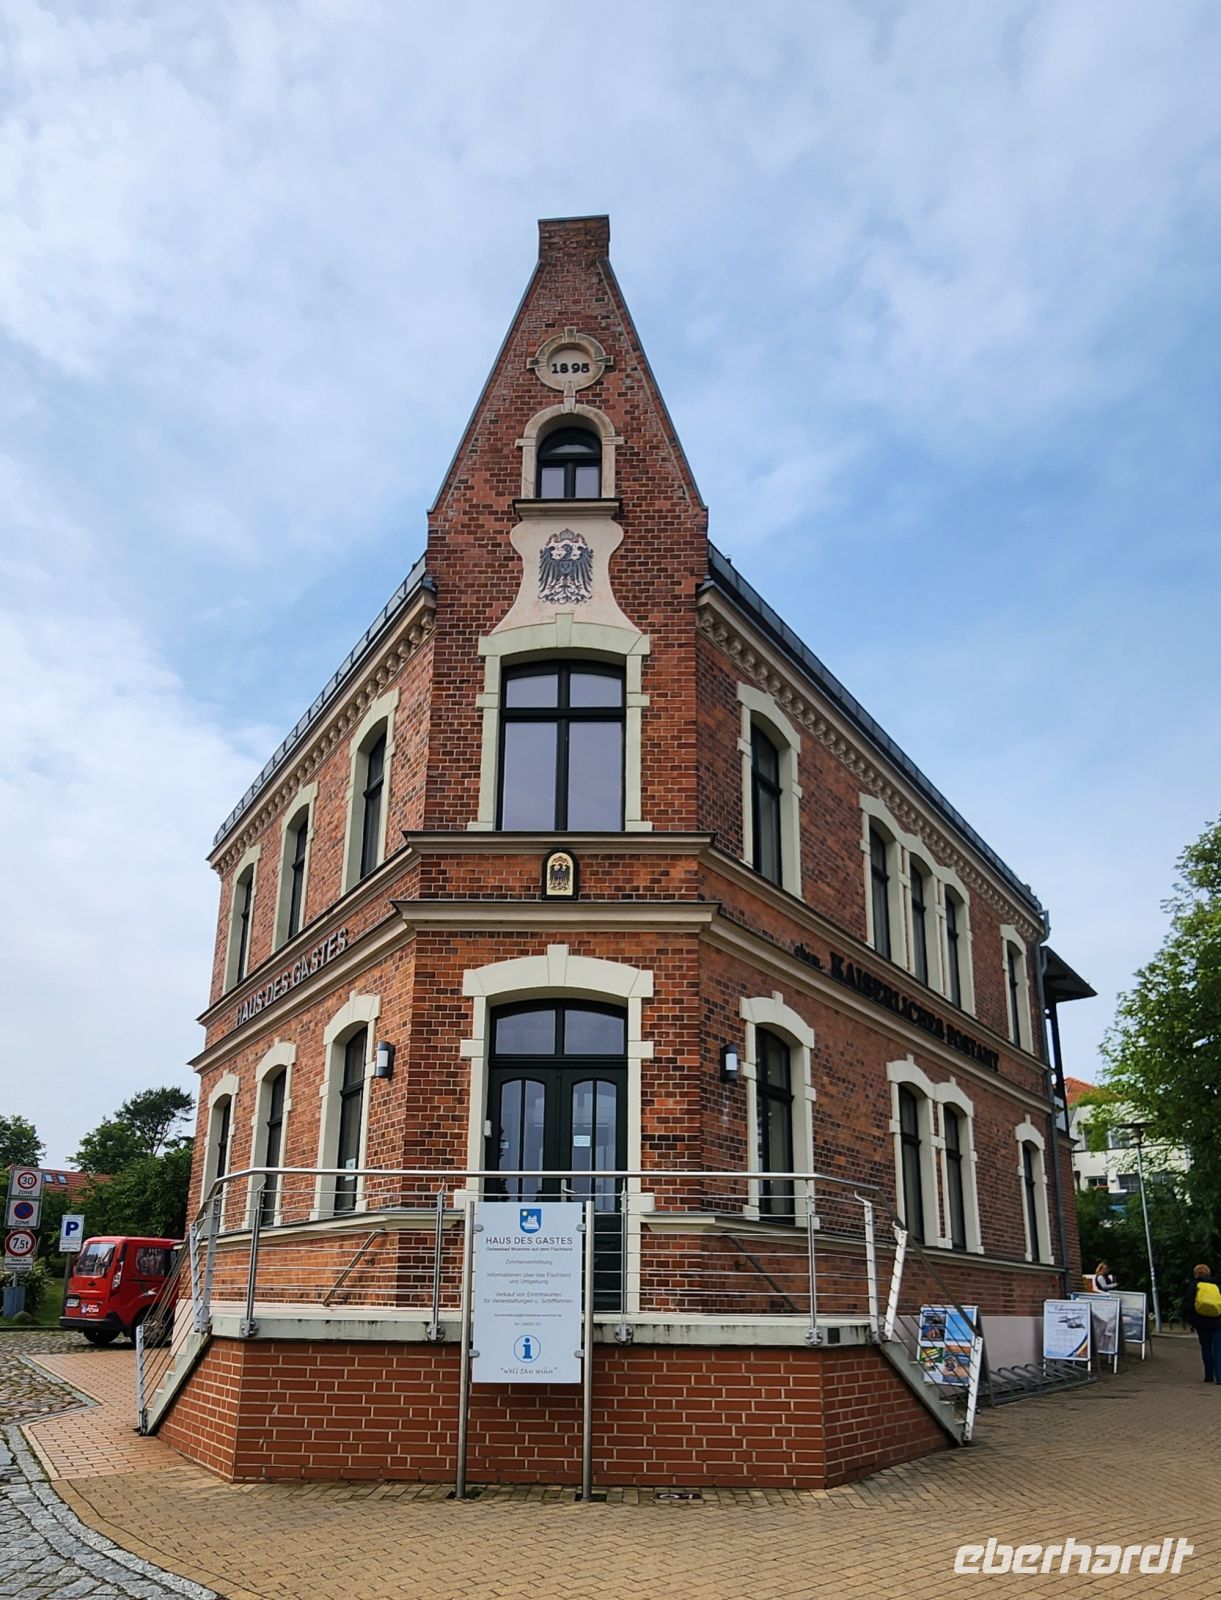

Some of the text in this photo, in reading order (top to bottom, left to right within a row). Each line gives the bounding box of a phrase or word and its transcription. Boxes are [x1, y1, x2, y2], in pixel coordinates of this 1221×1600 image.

[551, 362, 590, 374] 1895
[236, 927, 349, 1027] HAUS DES GASTES
[21, 1176, 34, 1185] 30
[65, 1221, 79, 1236] P
[485, 1236, 573, 1245] HAUS DES GASTES
